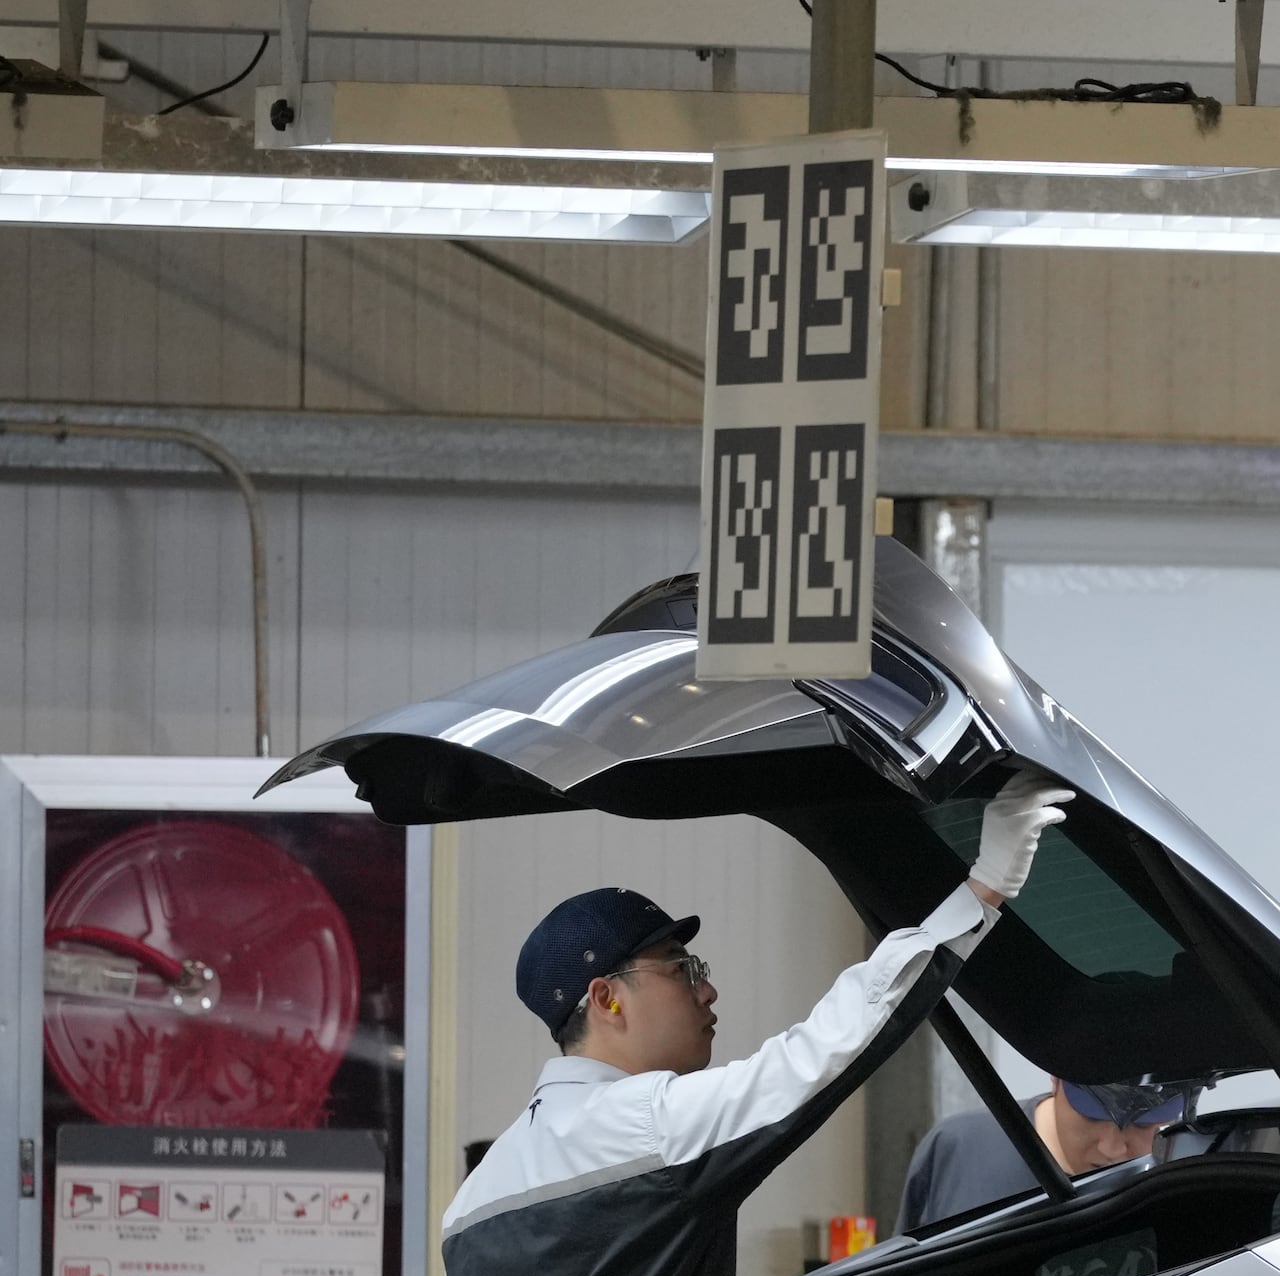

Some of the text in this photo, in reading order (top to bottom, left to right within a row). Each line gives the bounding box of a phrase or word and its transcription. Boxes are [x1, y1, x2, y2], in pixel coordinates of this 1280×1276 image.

[152, 1136, 287, 1158] 消火栓使用方法
